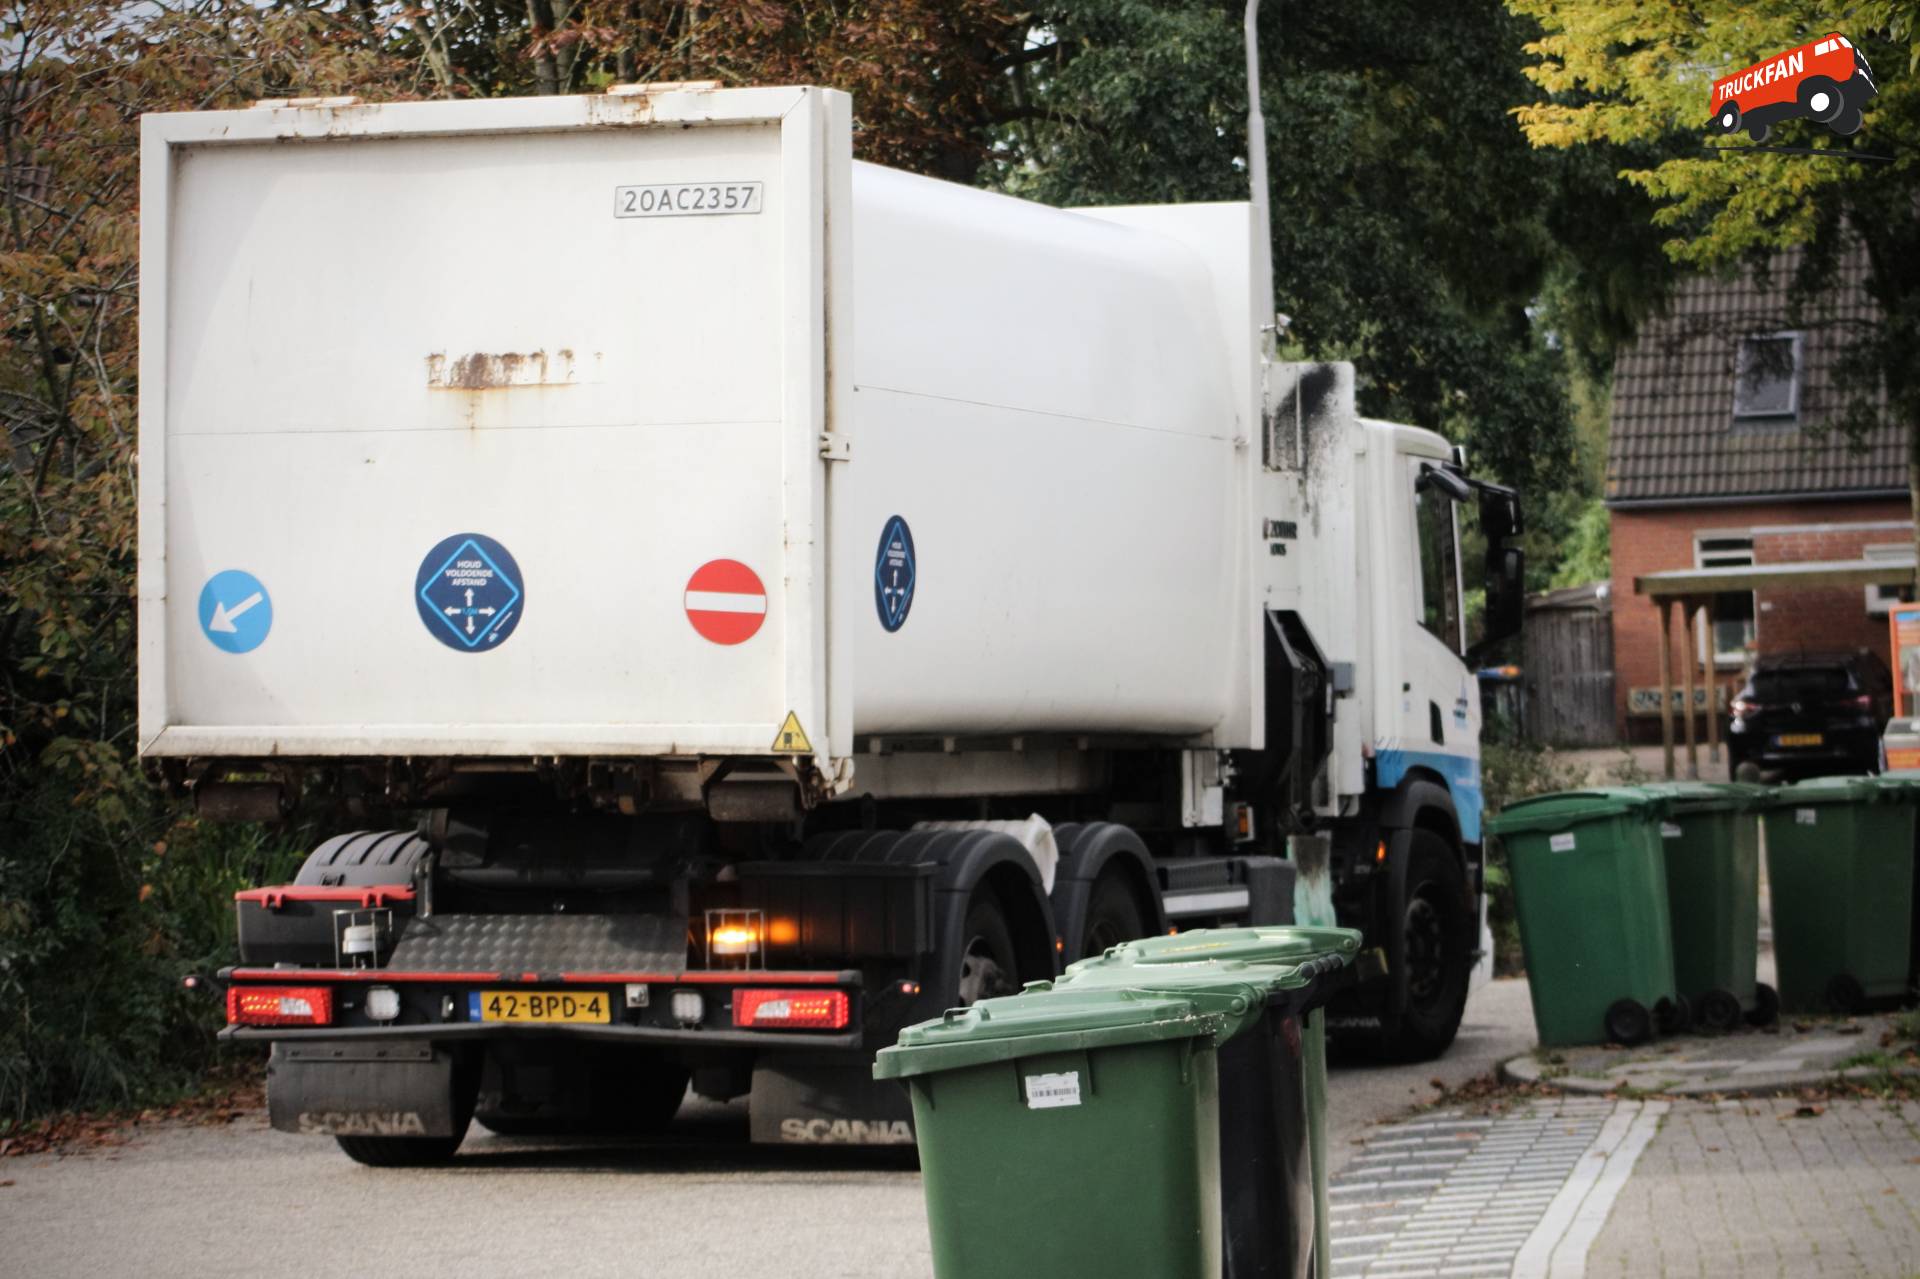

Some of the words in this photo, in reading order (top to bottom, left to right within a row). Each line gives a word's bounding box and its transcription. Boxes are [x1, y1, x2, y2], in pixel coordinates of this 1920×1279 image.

[623, 186, 755, 213] 20AC2357
[456, 560, 482, 569] HOUD
[451, 578, 488, 586] AFSTAND
[488, 995, 602, 1018] 42-BPD-4
[298, 1111, 425, 1136] SCANIA
[780, 1117, 915, 1144] SCANIA
